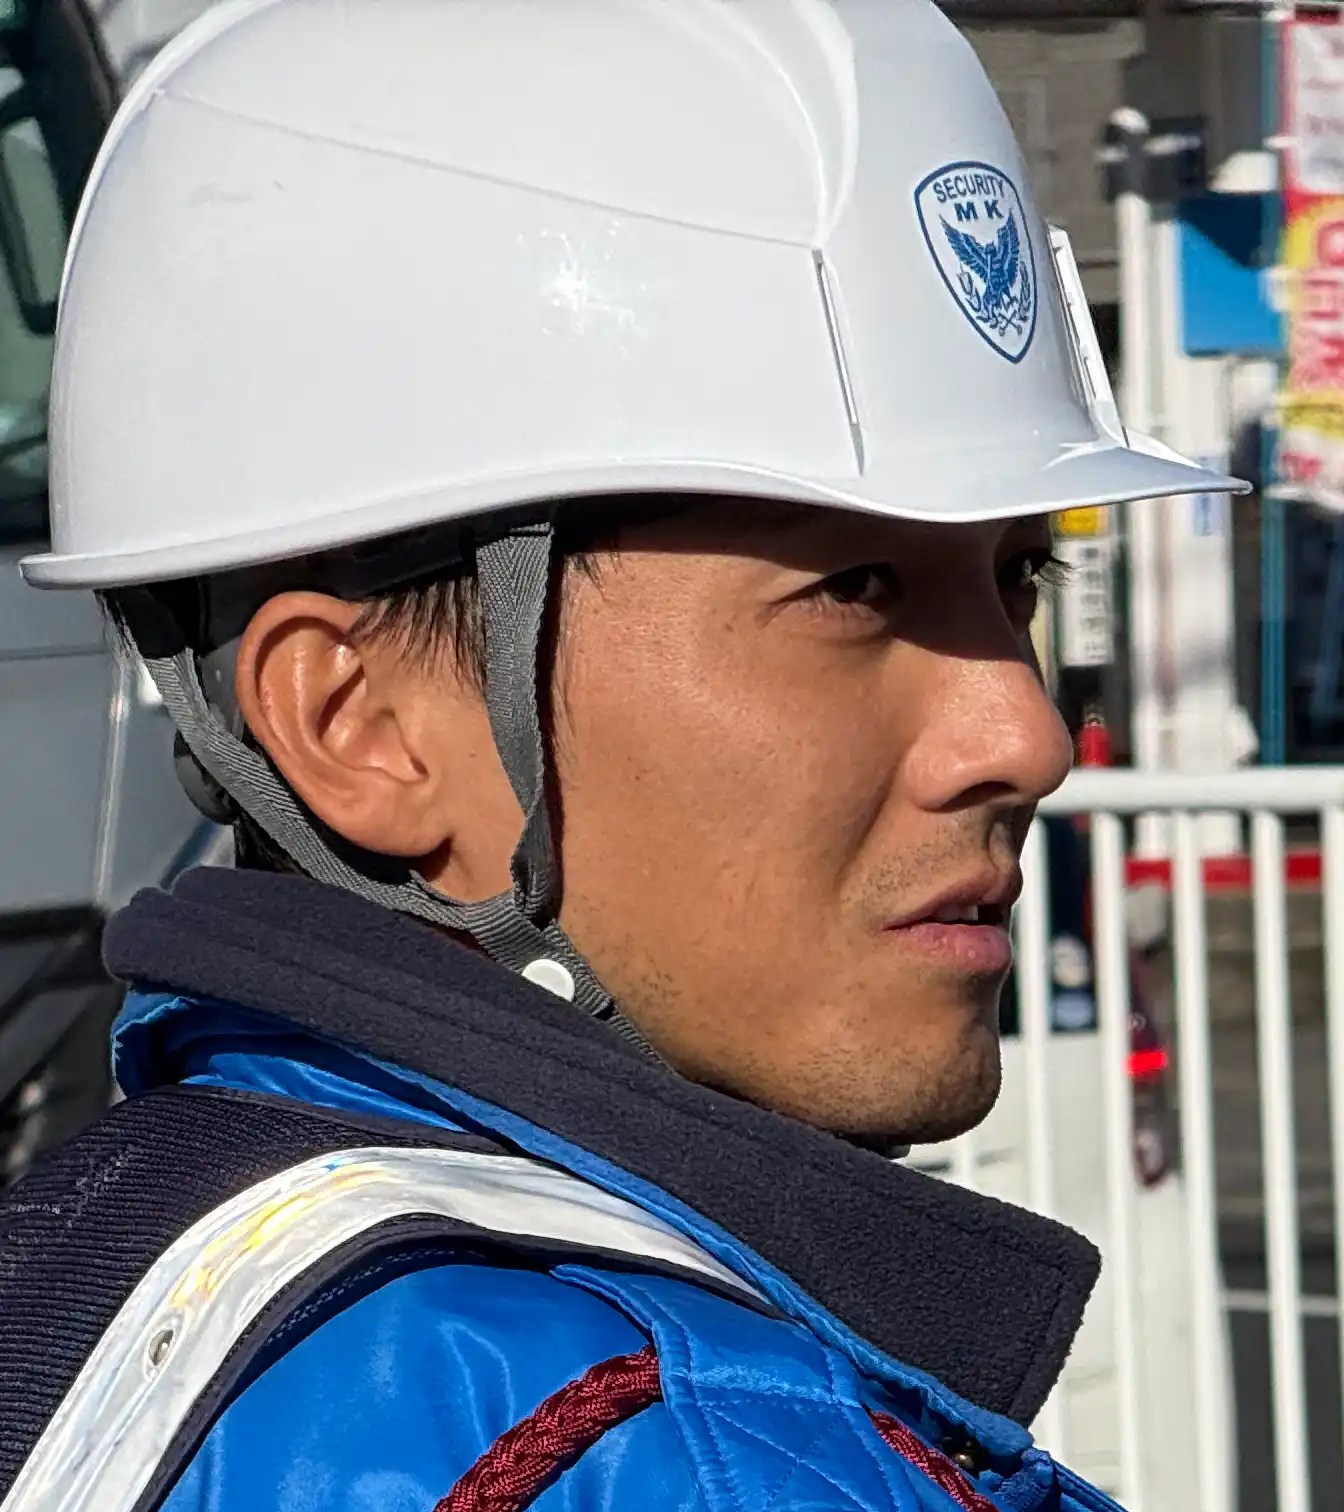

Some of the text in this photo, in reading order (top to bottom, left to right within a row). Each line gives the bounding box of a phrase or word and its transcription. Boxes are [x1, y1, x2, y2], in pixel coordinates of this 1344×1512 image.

[933, 174, 1005, 203] SECURITY
[954, 200, 1004, 222] M K
